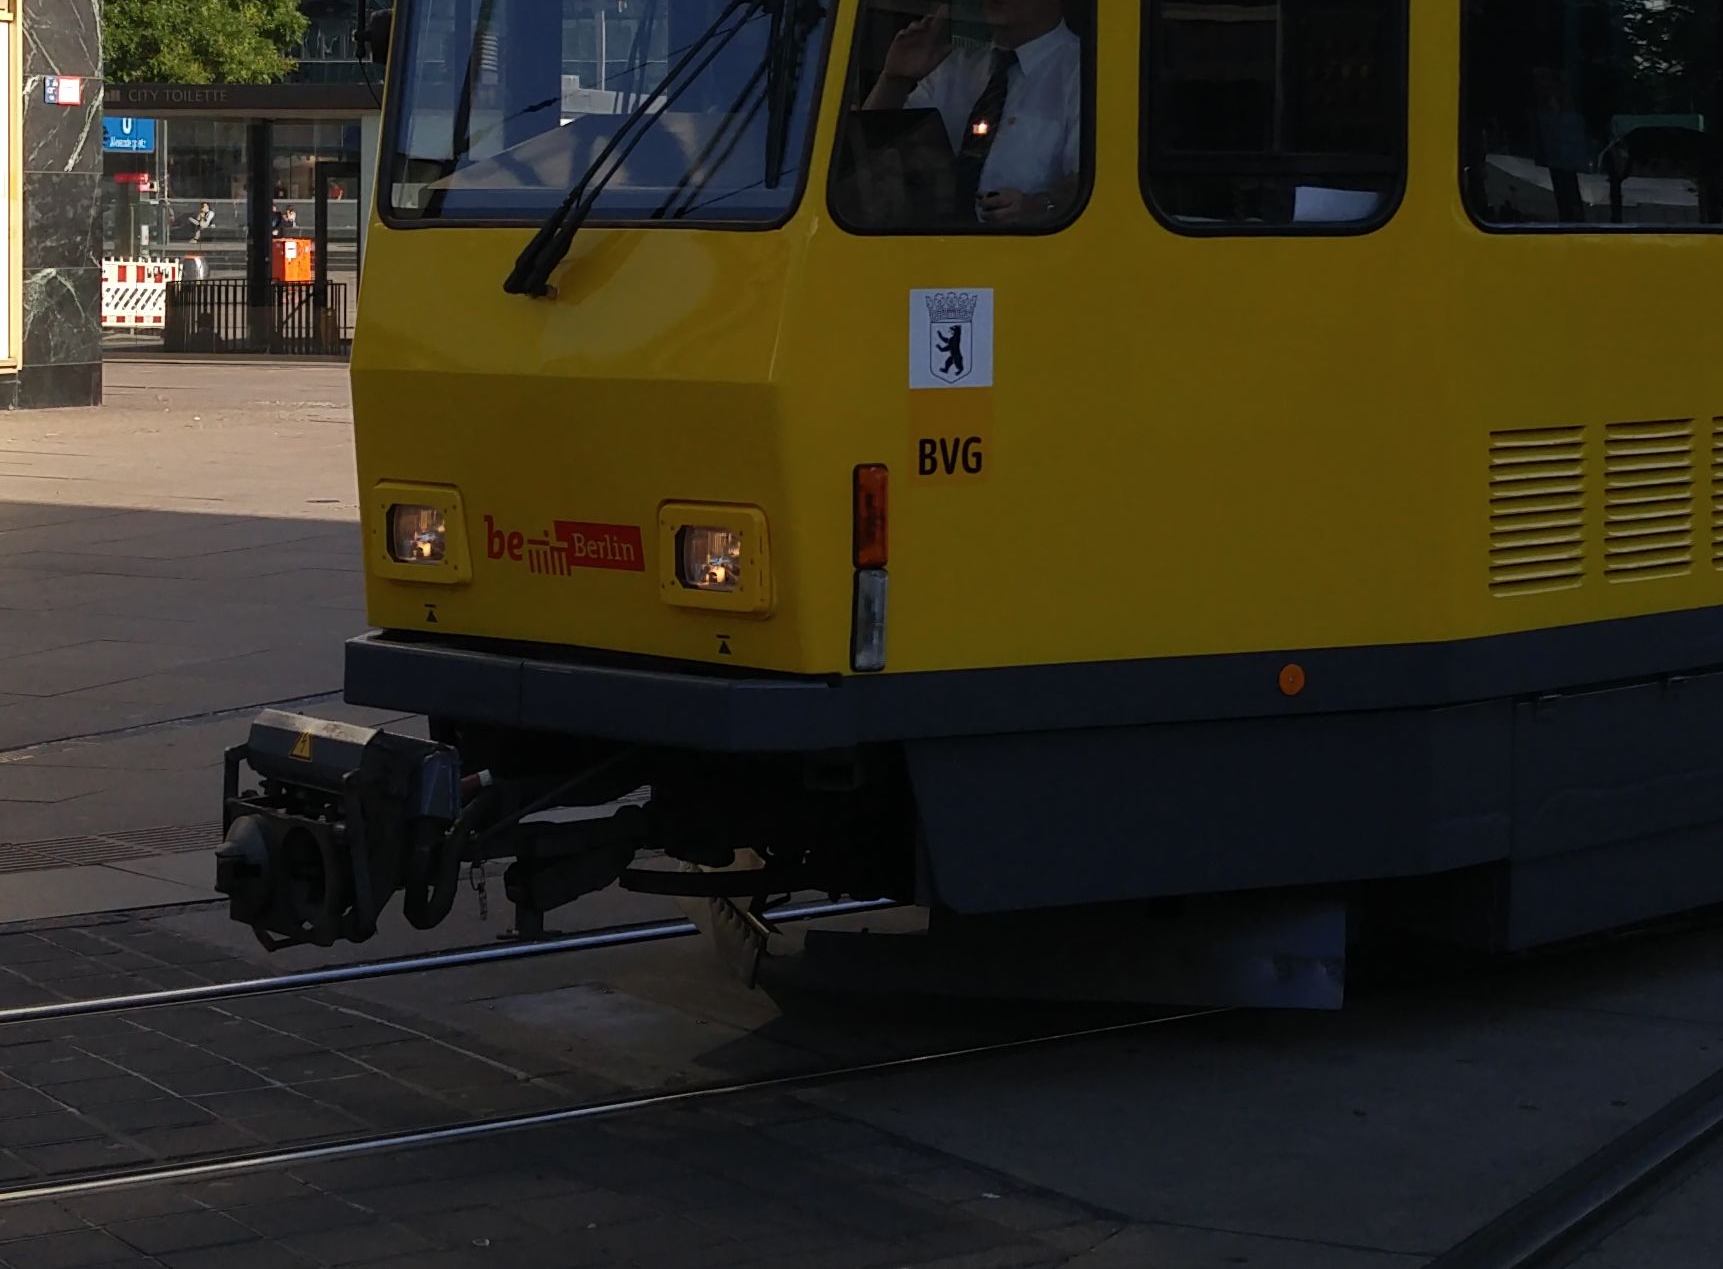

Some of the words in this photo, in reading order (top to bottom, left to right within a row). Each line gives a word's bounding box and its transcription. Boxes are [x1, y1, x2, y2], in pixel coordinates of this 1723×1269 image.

[128, 89, 158, 102] CITY
[165, 89, 228, 102] TOILETTE
[918, 436, 984, 476] BVG
[483, 514, 524, 561] be
[571, 532, 635, 562] Berlin
